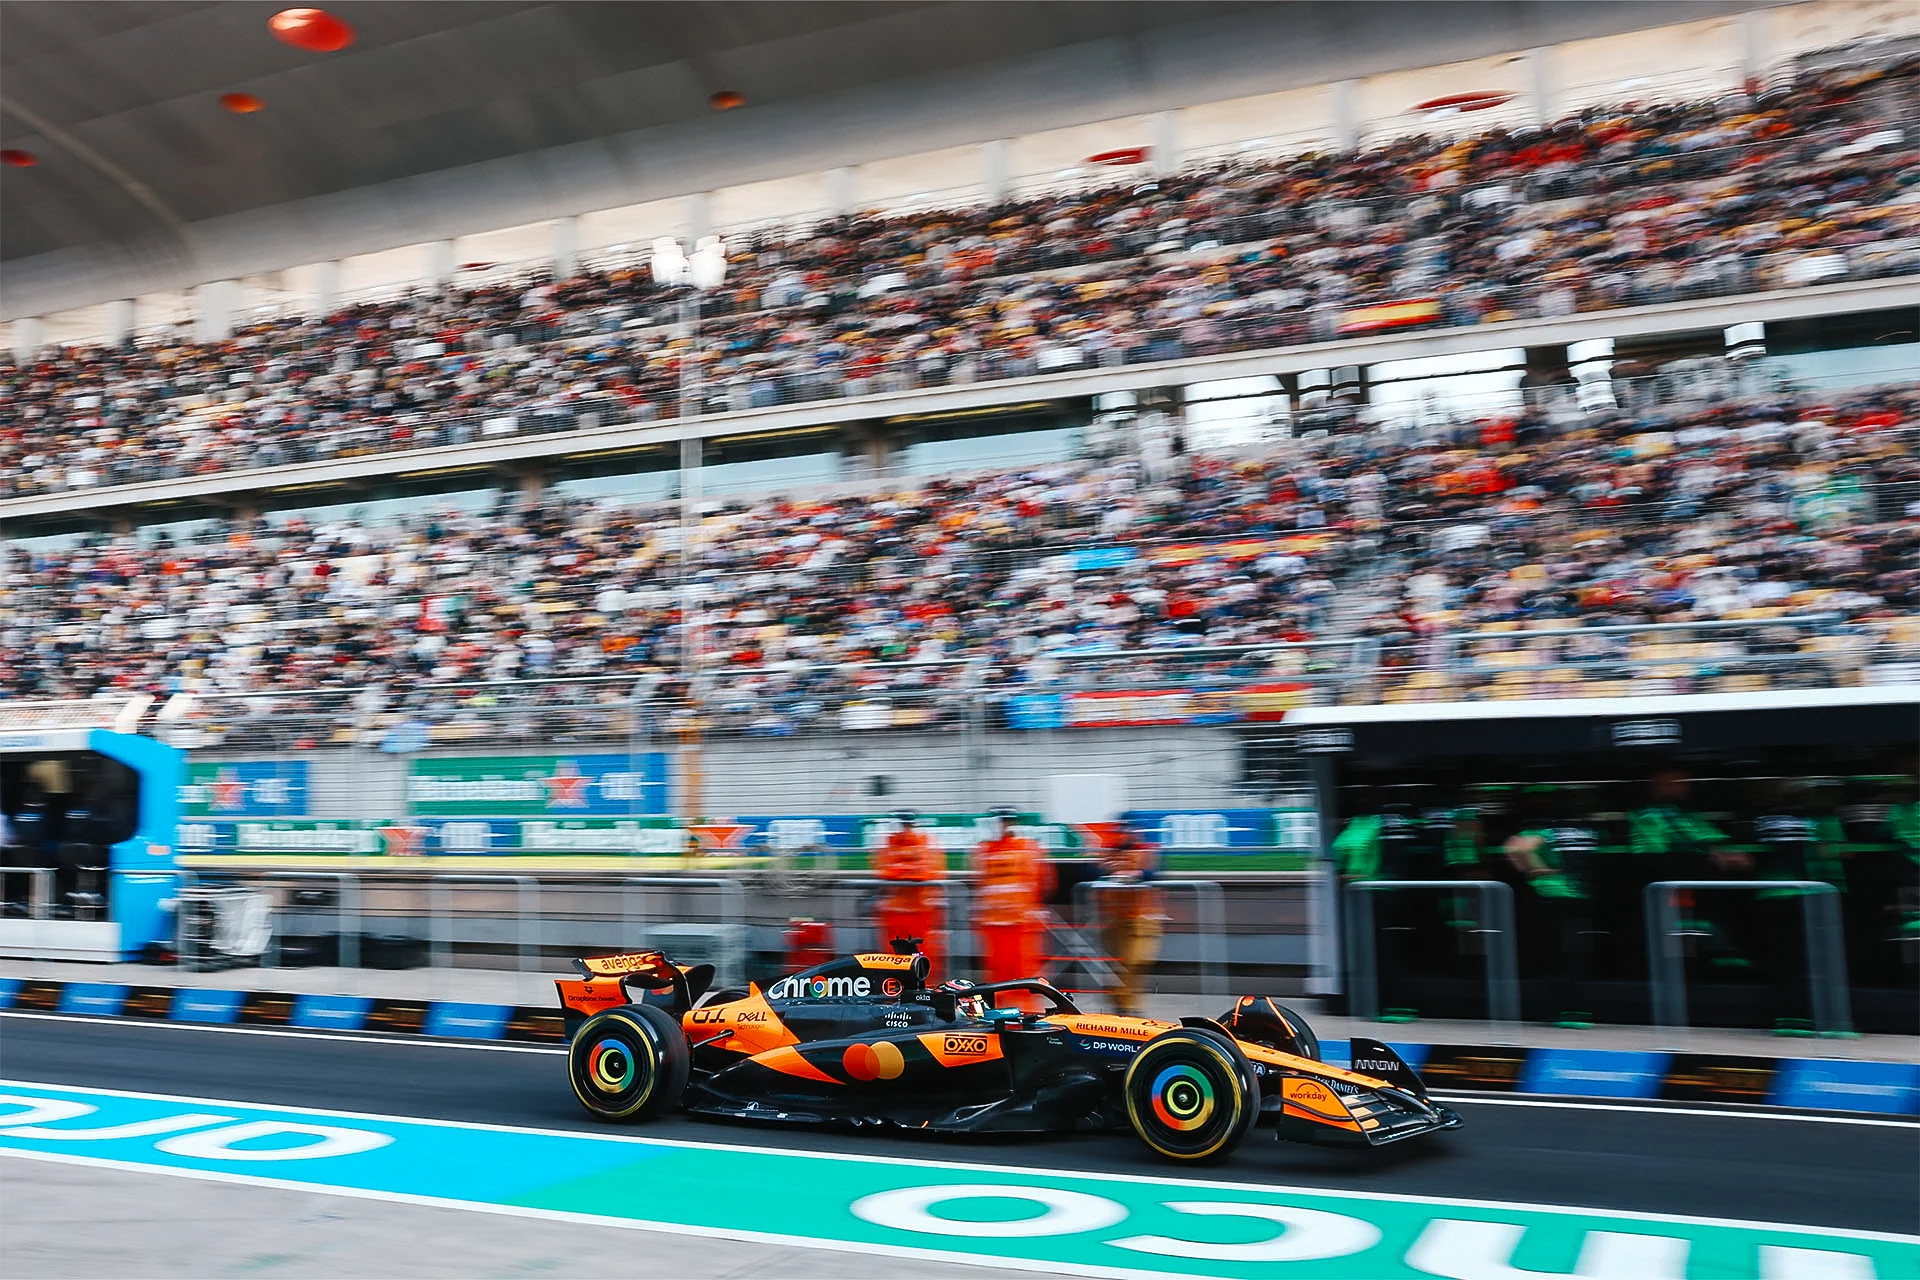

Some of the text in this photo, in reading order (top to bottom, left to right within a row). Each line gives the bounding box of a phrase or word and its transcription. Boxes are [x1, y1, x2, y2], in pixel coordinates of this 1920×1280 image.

[601, 956, 643, 970] avenga
[862, 955, 911, 965] avenga
[737, 1011, 767, 1023] DELL
[1075, 1022, 1149, 1037] RICHARD MILLE
[945, 1037, 987, 1053] OXXO
[1093, 1041, 1107, 1050] DP
[1354, 1059, 1400, 1071] ARROW
[1290, 1091, 1328, 1102] workday
